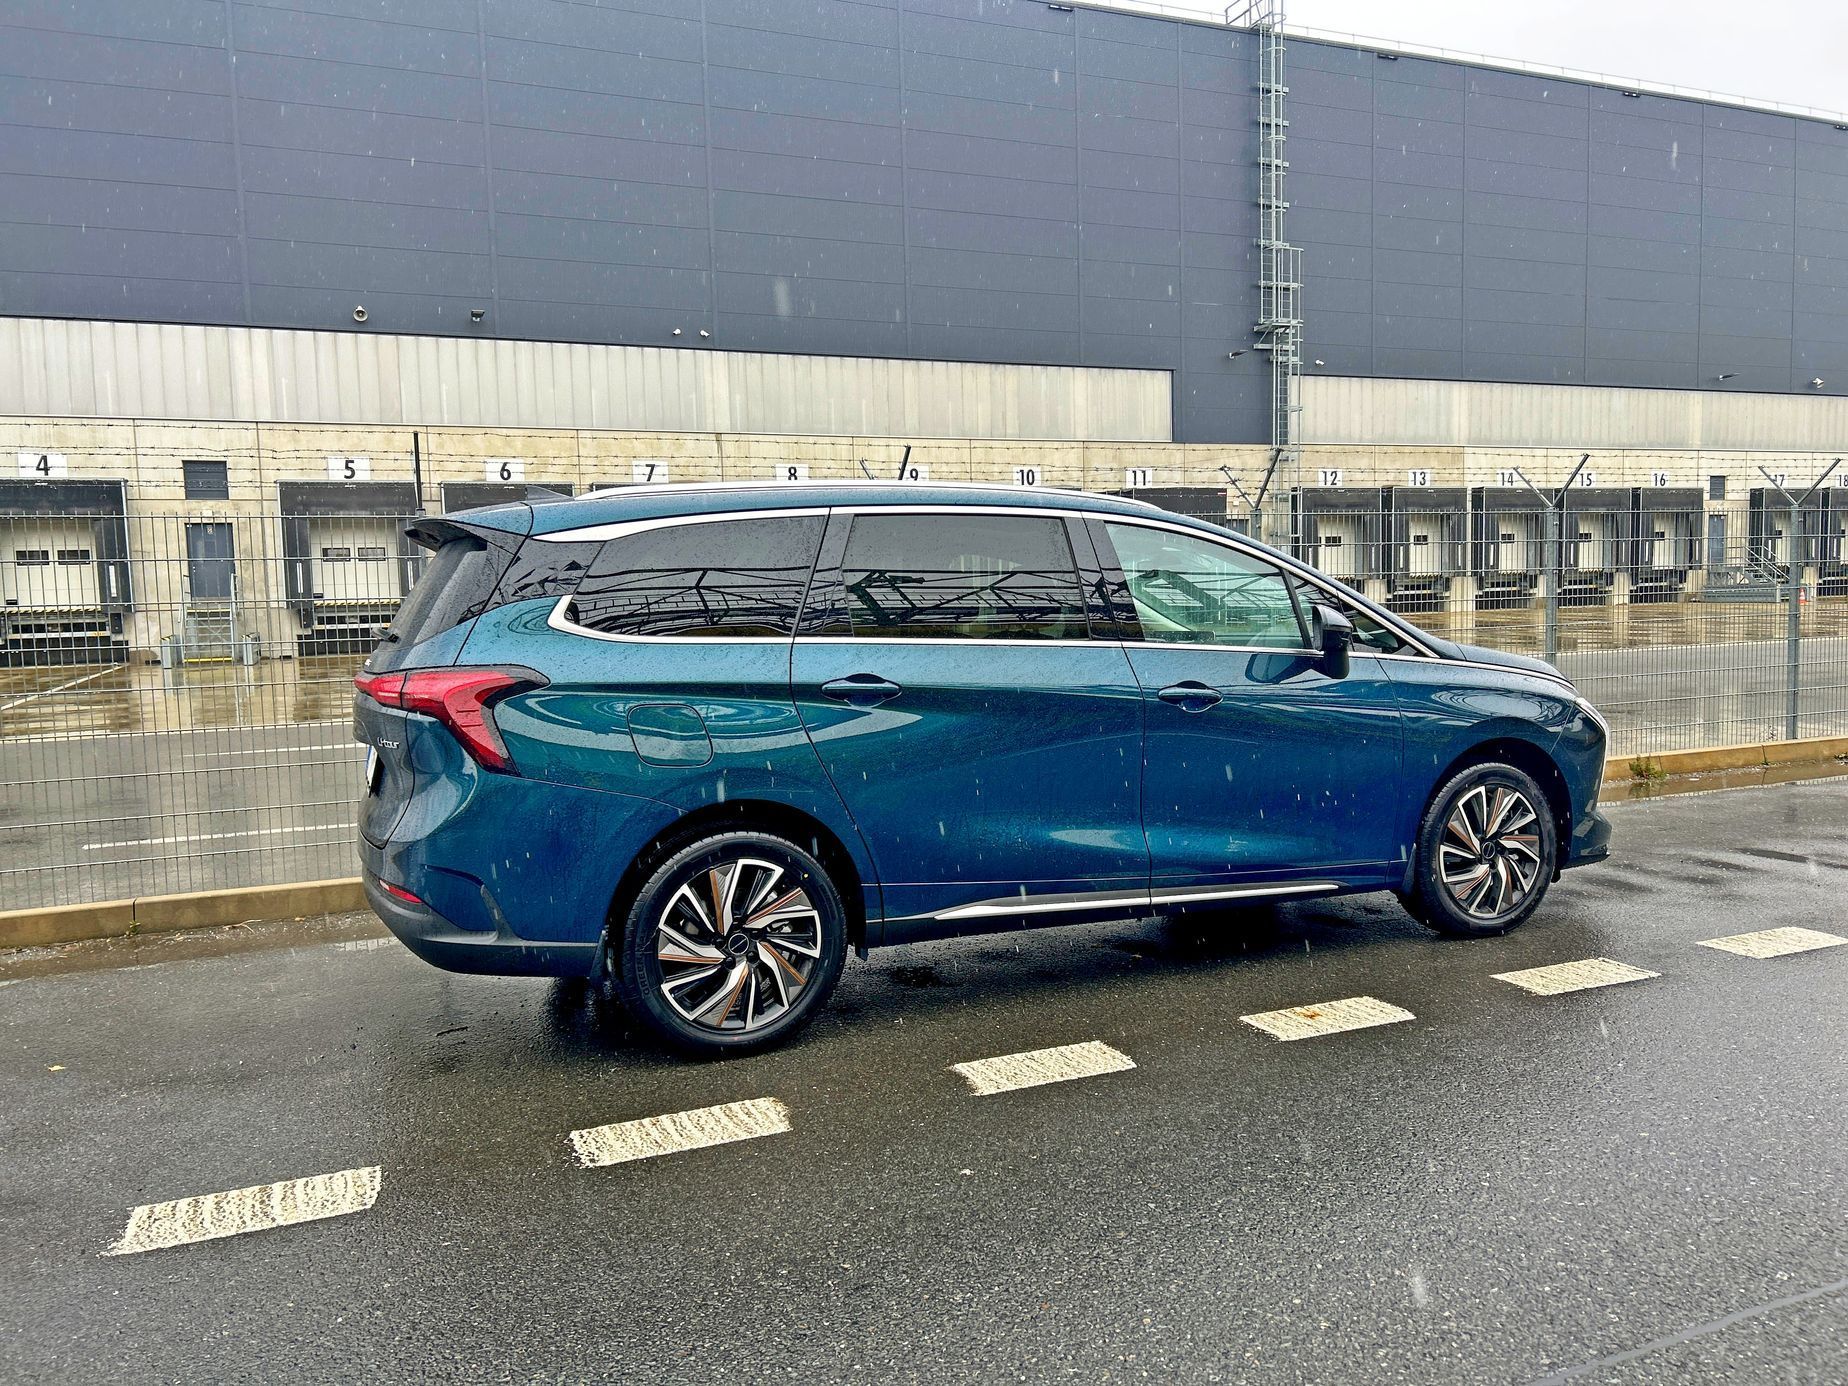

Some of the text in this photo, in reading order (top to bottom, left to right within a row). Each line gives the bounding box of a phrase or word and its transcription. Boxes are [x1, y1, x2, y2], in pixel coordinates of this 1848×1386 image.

[36, 455, 50, 476] 4
[344, 459, 356, 479] 5
[500, 462, 511, 481] 6
[645, 463, 656, 482] 7
[788, 466, 798, 481] 8
[910, 468, 919, 481] 9
[1019, 469, 1035, 486] 10
[1132, 470, 1147, 486] 11
[1322, 470, 1338, 486] 12
[1412, 471, 1427, 486] 13
[1501, 472, 1514, 486] 14
[1580, 473, 1592, 487] 15
[1653, 473, 1666, 487] 16
